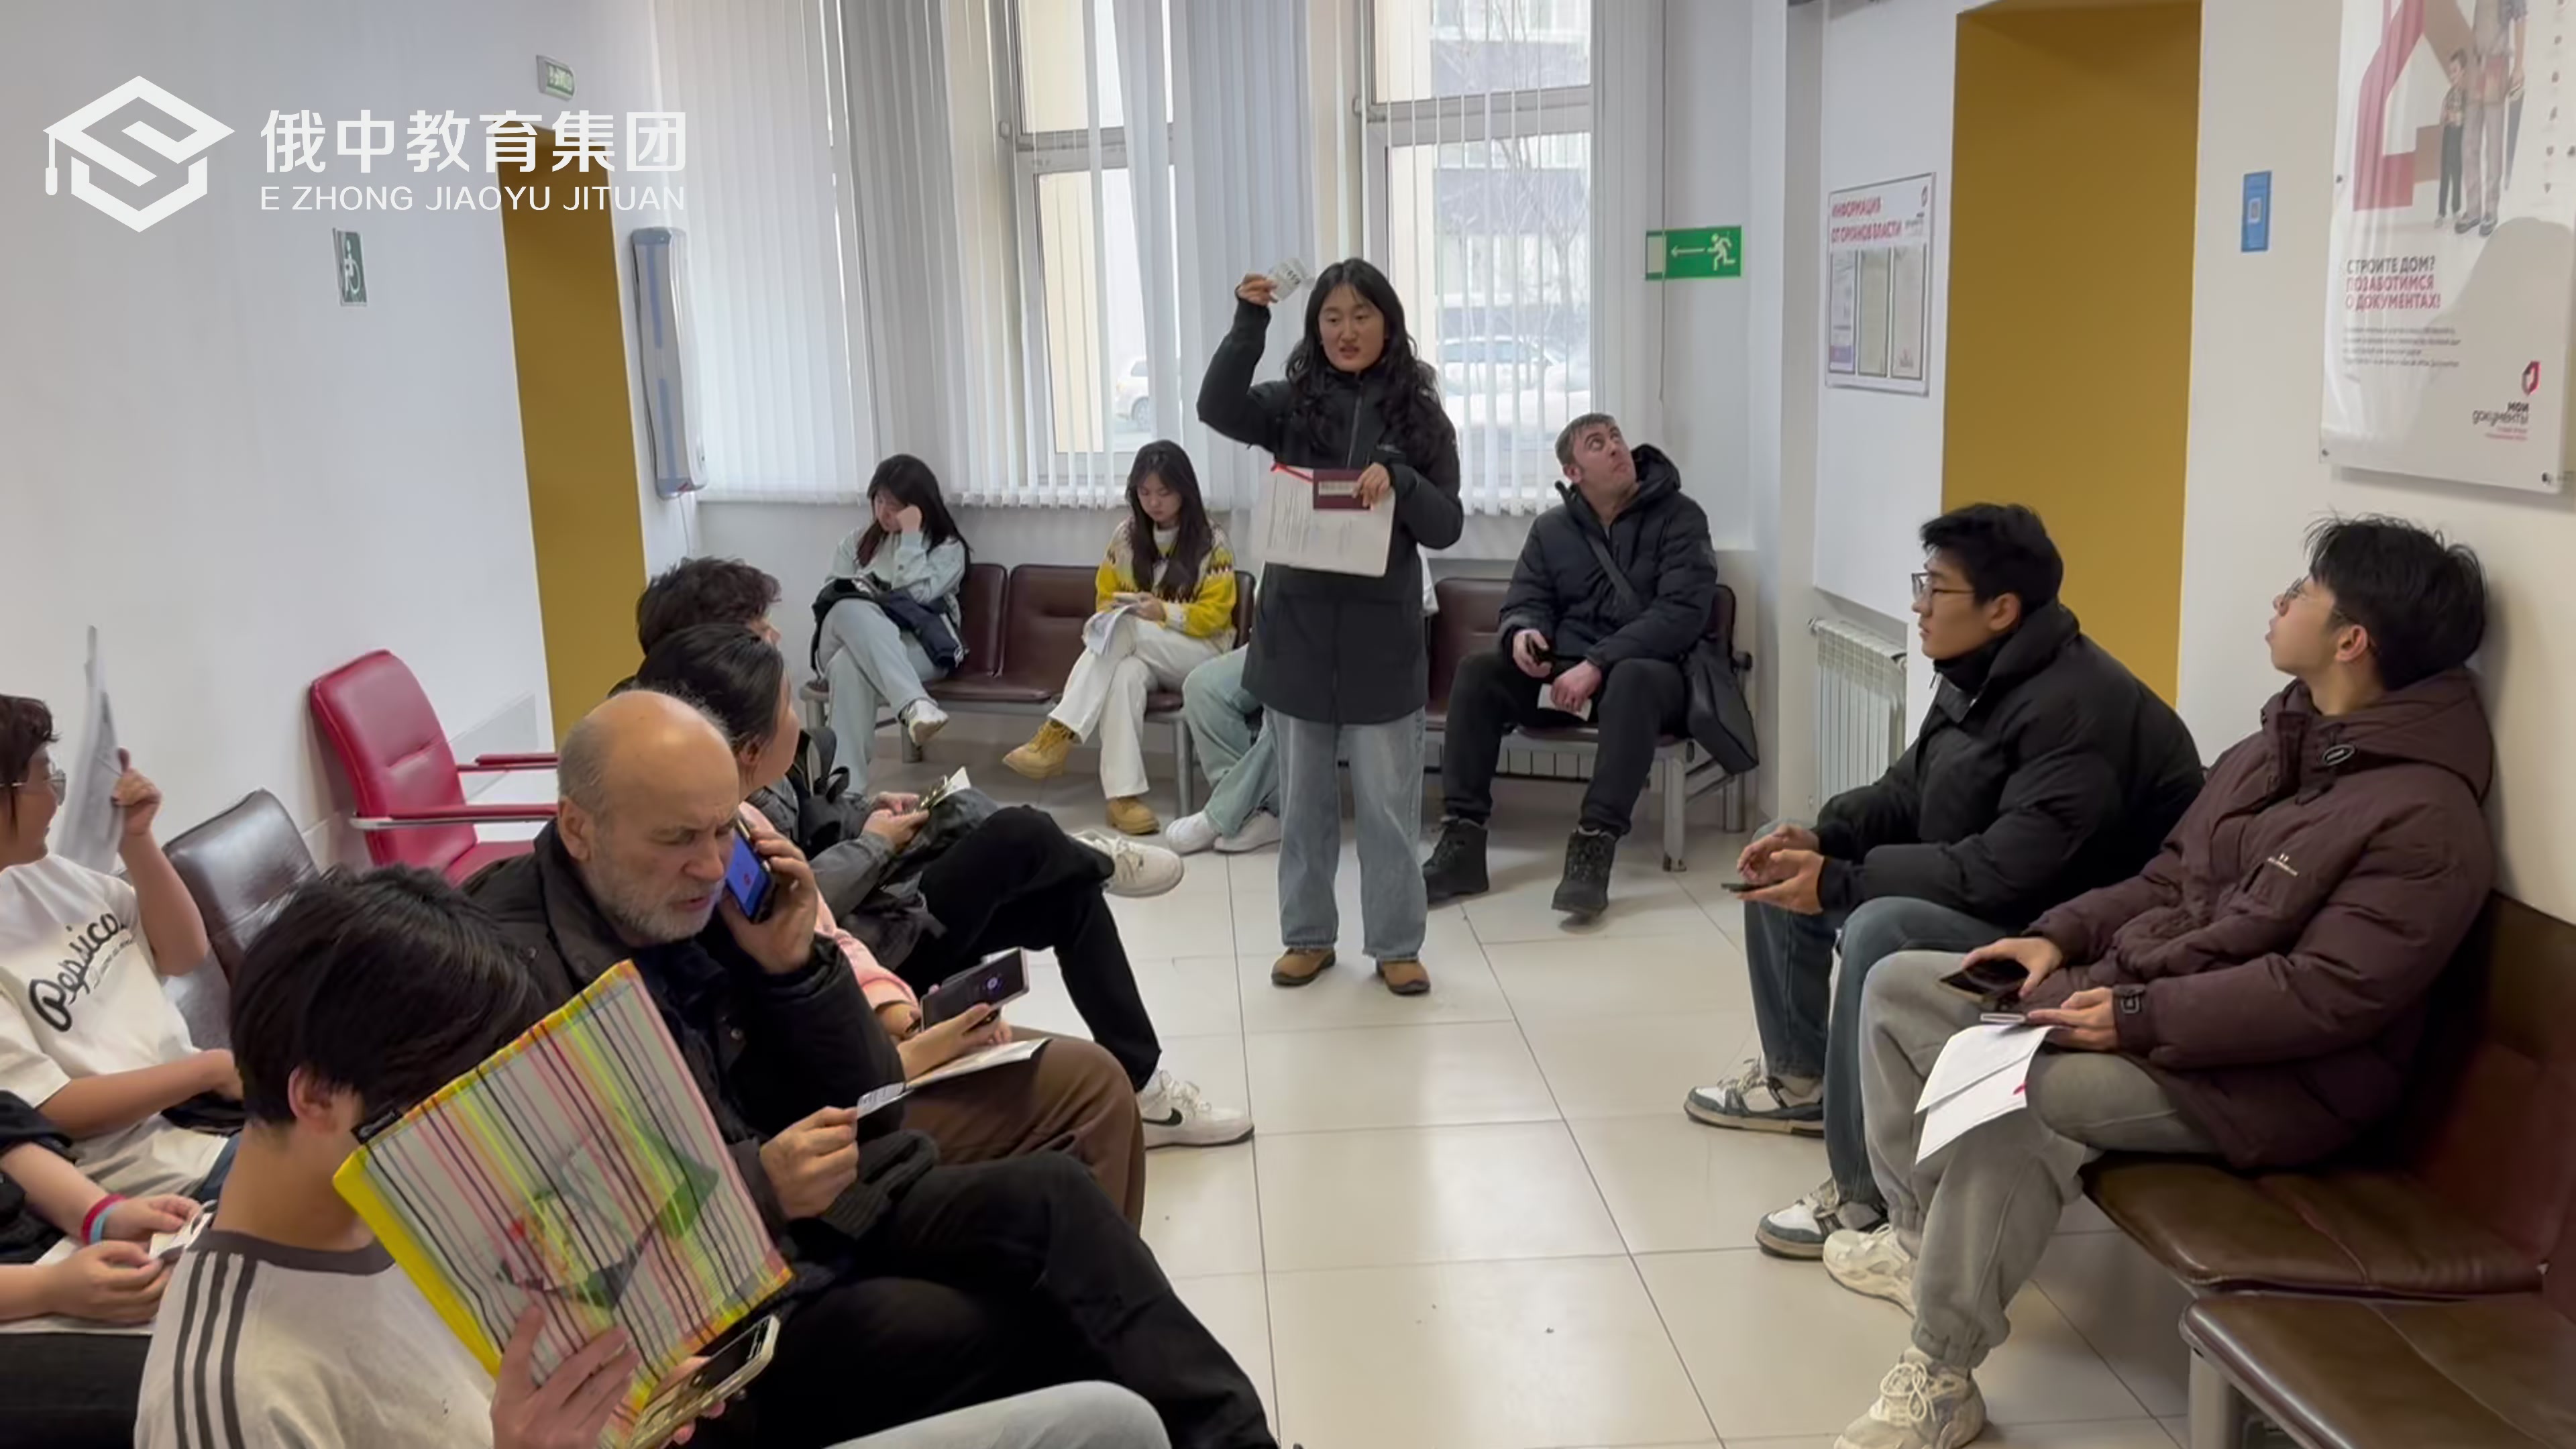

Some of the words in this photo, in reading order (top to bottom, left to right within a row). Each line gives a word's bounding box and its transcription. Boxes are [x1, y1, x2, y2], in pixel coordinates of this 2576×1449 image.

[2347, 257, 2398, 275] СТРОИТЕ
[2400, 255, 2436, 274] ДОМ?
[2346, 274, 2434, 292] ПОЗАБОТИМСЯ
[2346, 293, 2352, 309] О
[2356, 292, 2441, 311] ДОКУМЕНТАХ!
